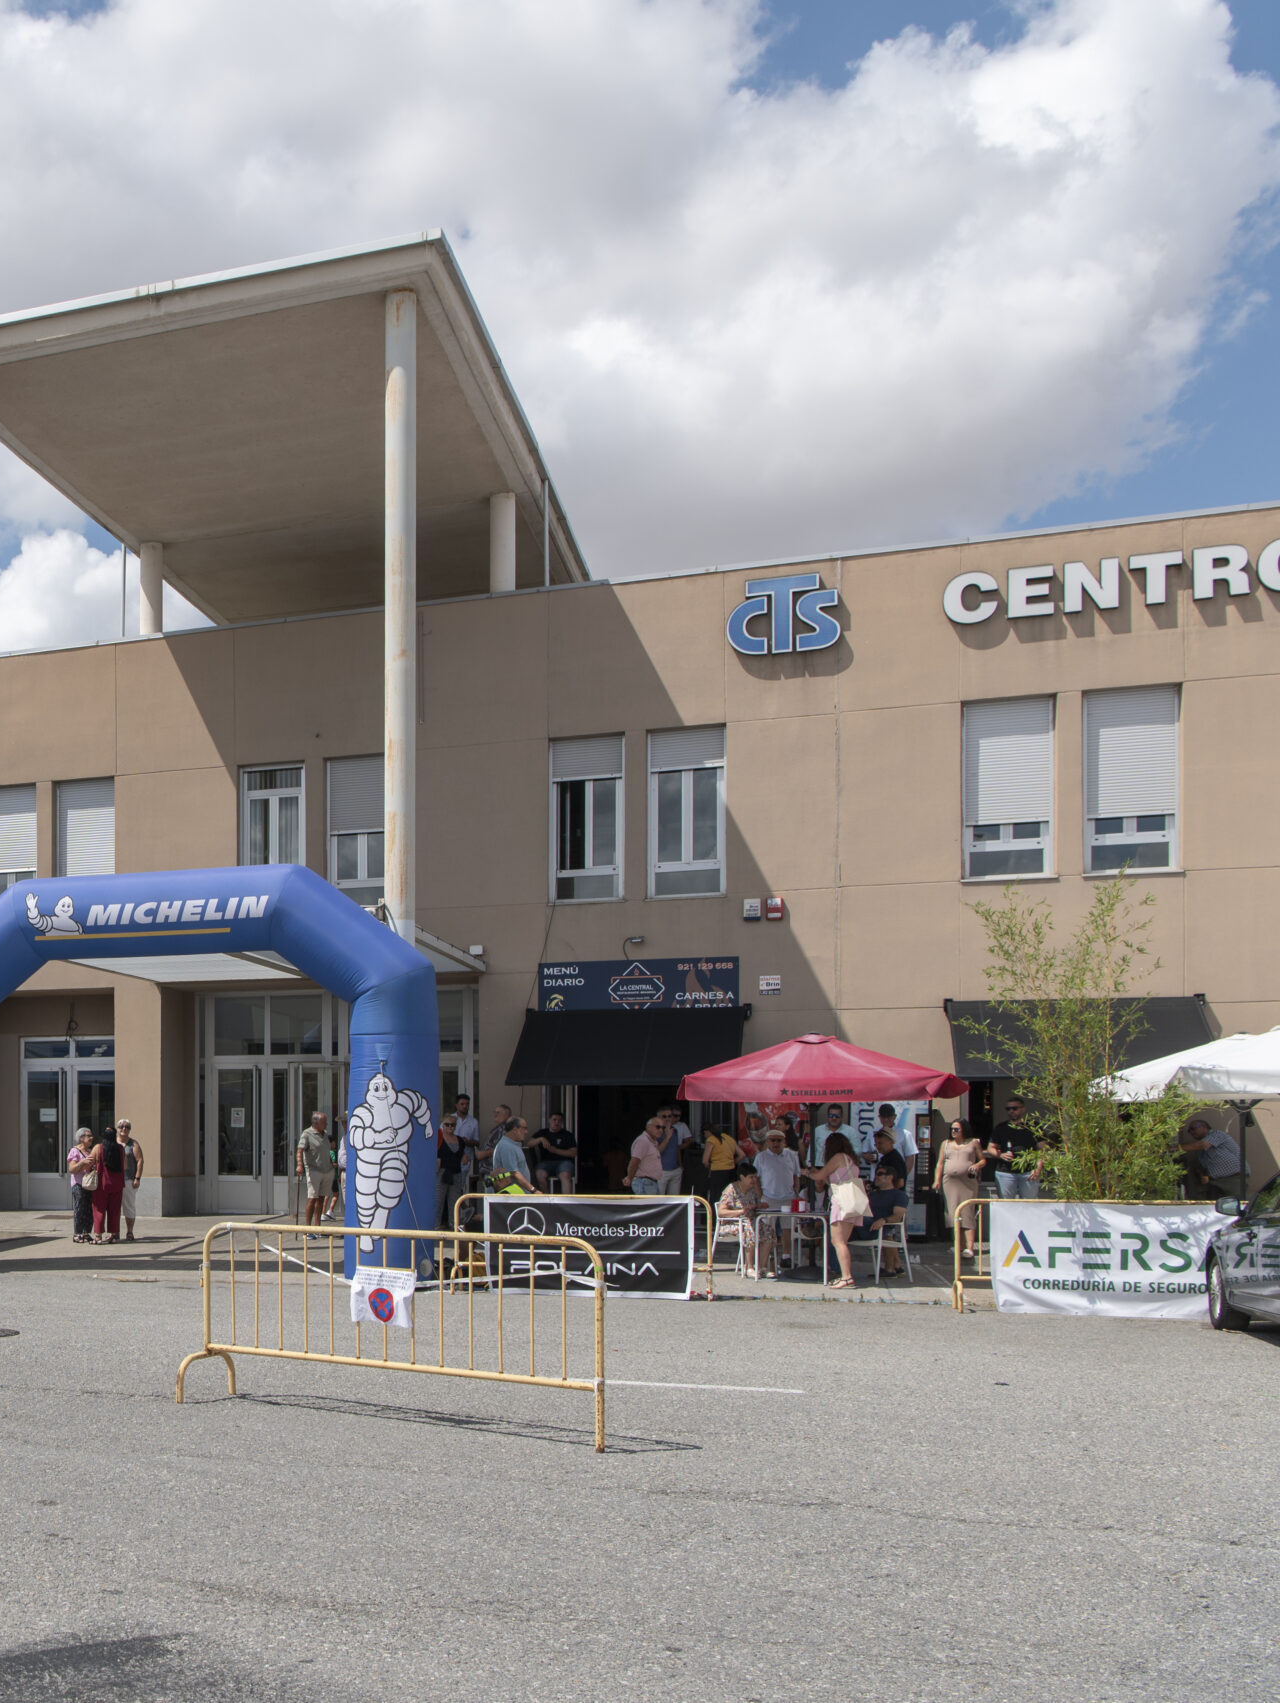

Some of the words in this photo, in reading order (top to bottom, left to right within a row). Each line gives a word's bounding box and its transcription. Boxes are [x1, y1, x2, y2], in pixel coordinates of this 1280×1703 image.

[726, 573, 841, 655] CTS
[86, 895, 269, 927] MICHELIN
[543, 965, 579, 976] MENÚ
[543, 978, 585, 987] DIARIO
[675, 992, 724, 1000] CARNES
[726, 991, 734, 999] A
[555, 1223, 665, 1237] Mercedes-Benz
[1001, 1229, 1208, 1274] AFERS
[510, 1260, 660, 1276] POLAINA
[1022, 1277, 1116, 1293] CORREDURÍA
[1122, 1281, 1142, 1293] DE
